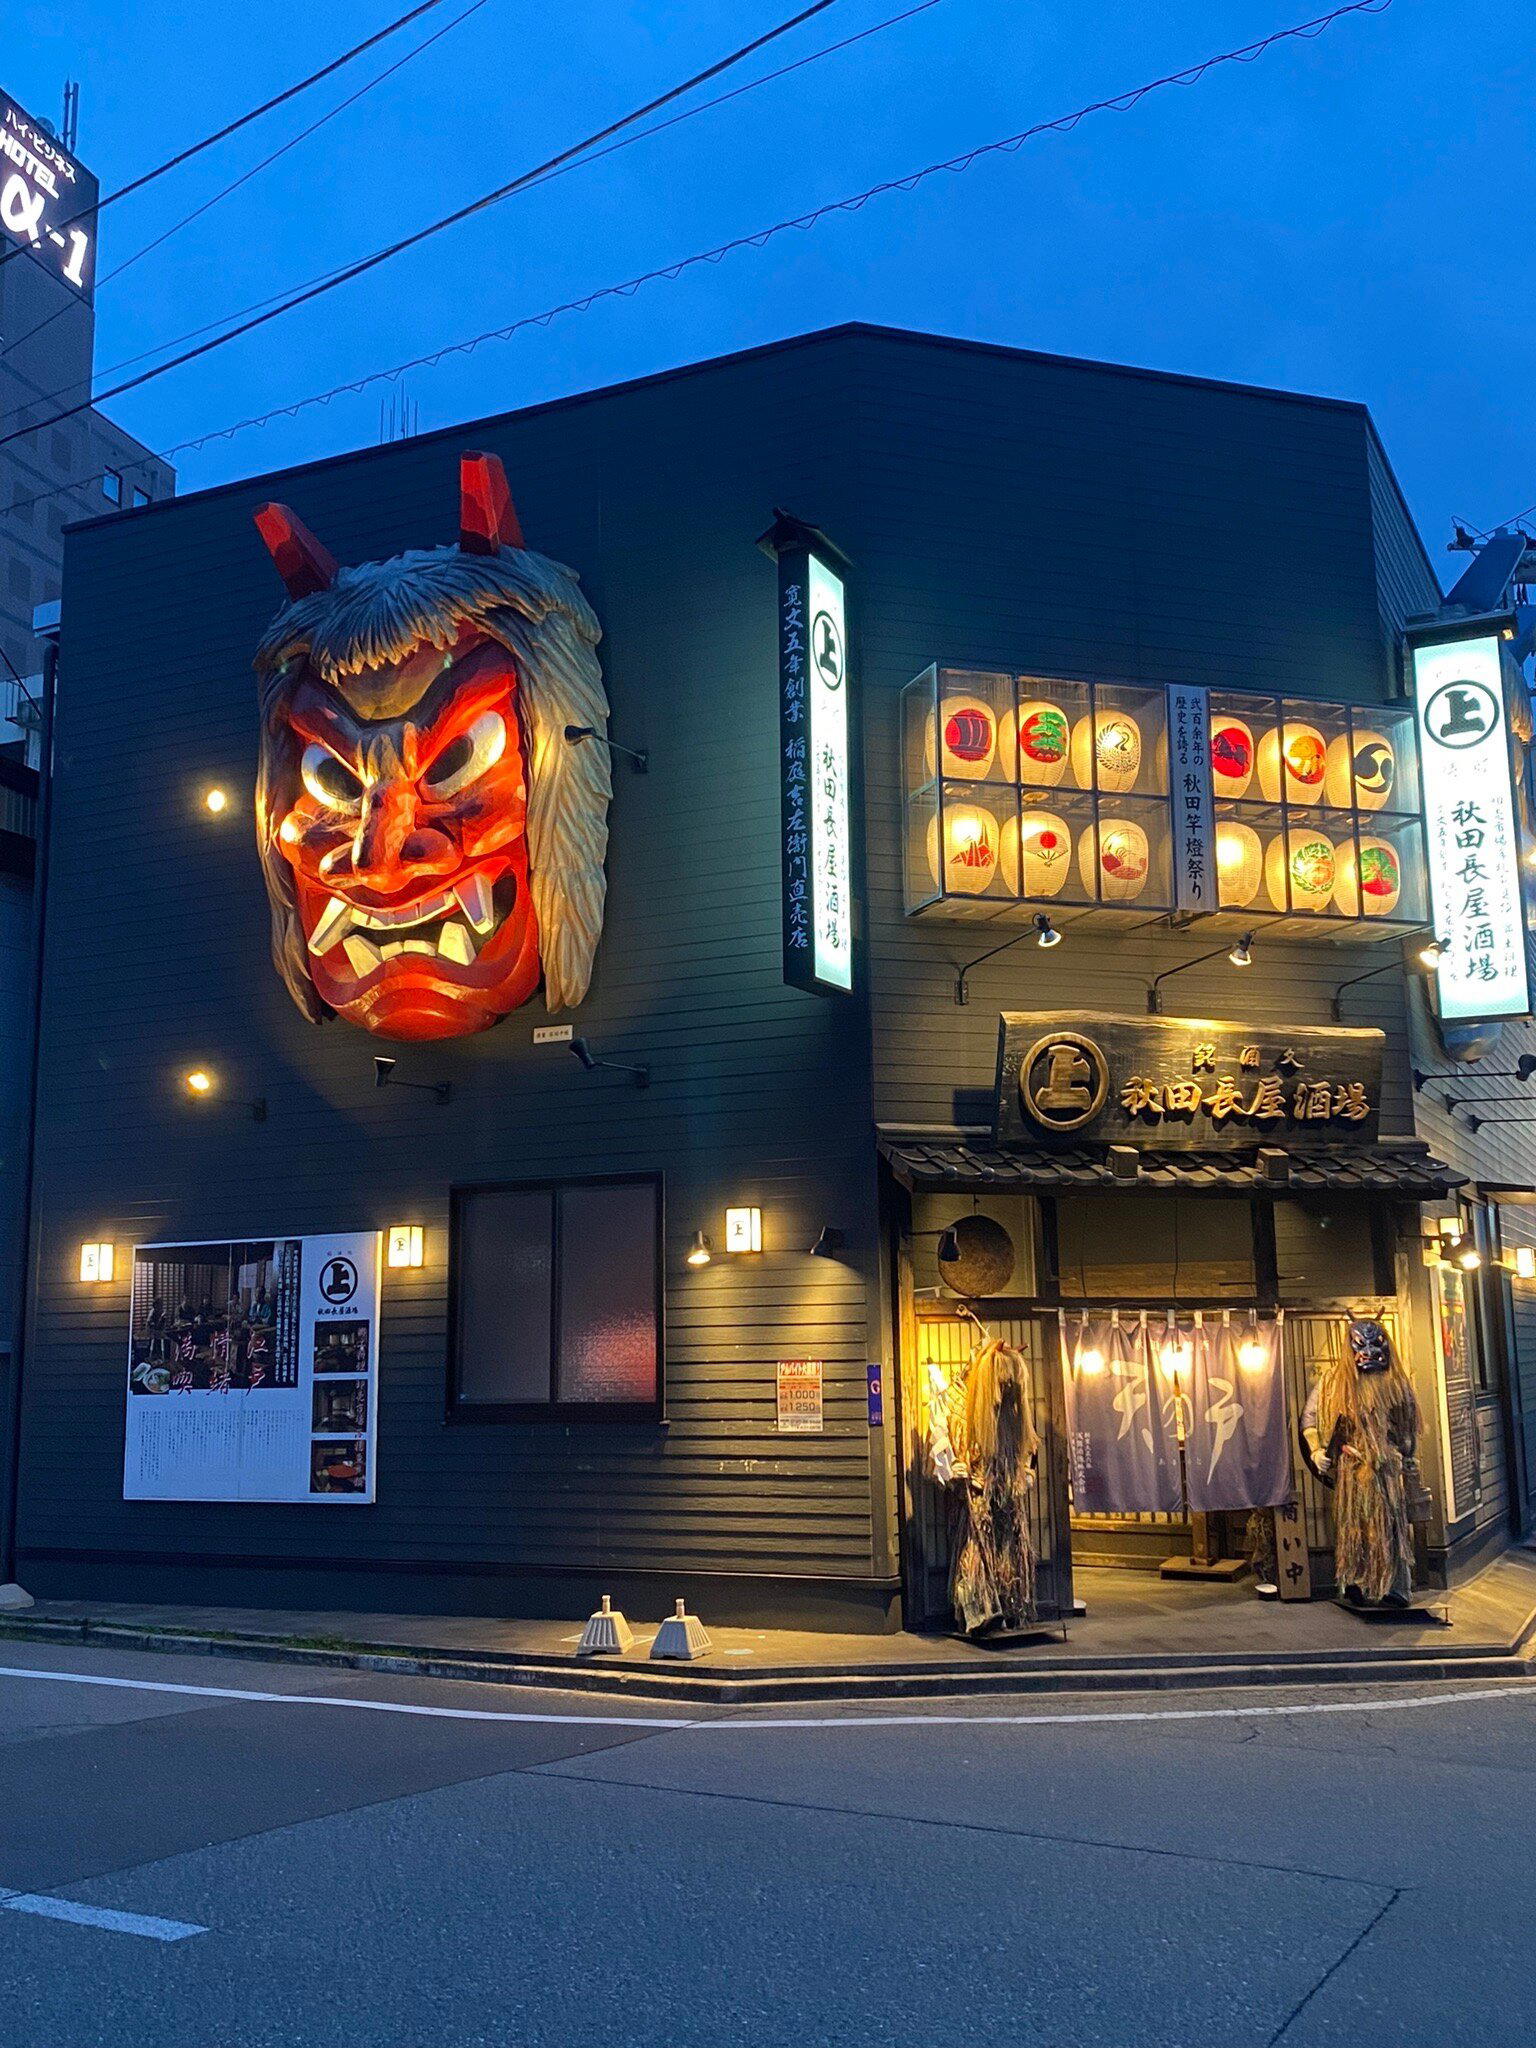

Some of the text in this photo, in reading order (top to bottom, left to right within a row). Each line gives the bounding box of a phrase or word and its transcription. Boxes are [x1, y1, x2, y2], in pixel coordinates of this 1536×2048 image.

[0, 128, 59, 199] HOTEL
[784, 584, 805, 724] 寛文五年創業
[821, 742, 841, 949] 秋田長屋酒場
[1182, 773, 1205, 901] 秋田竿燈祭り
[1450, 799, 1500, 983] 秋田長屋酒場
[1120, 1076, 1372, 1121] 秋田長屋酒場
